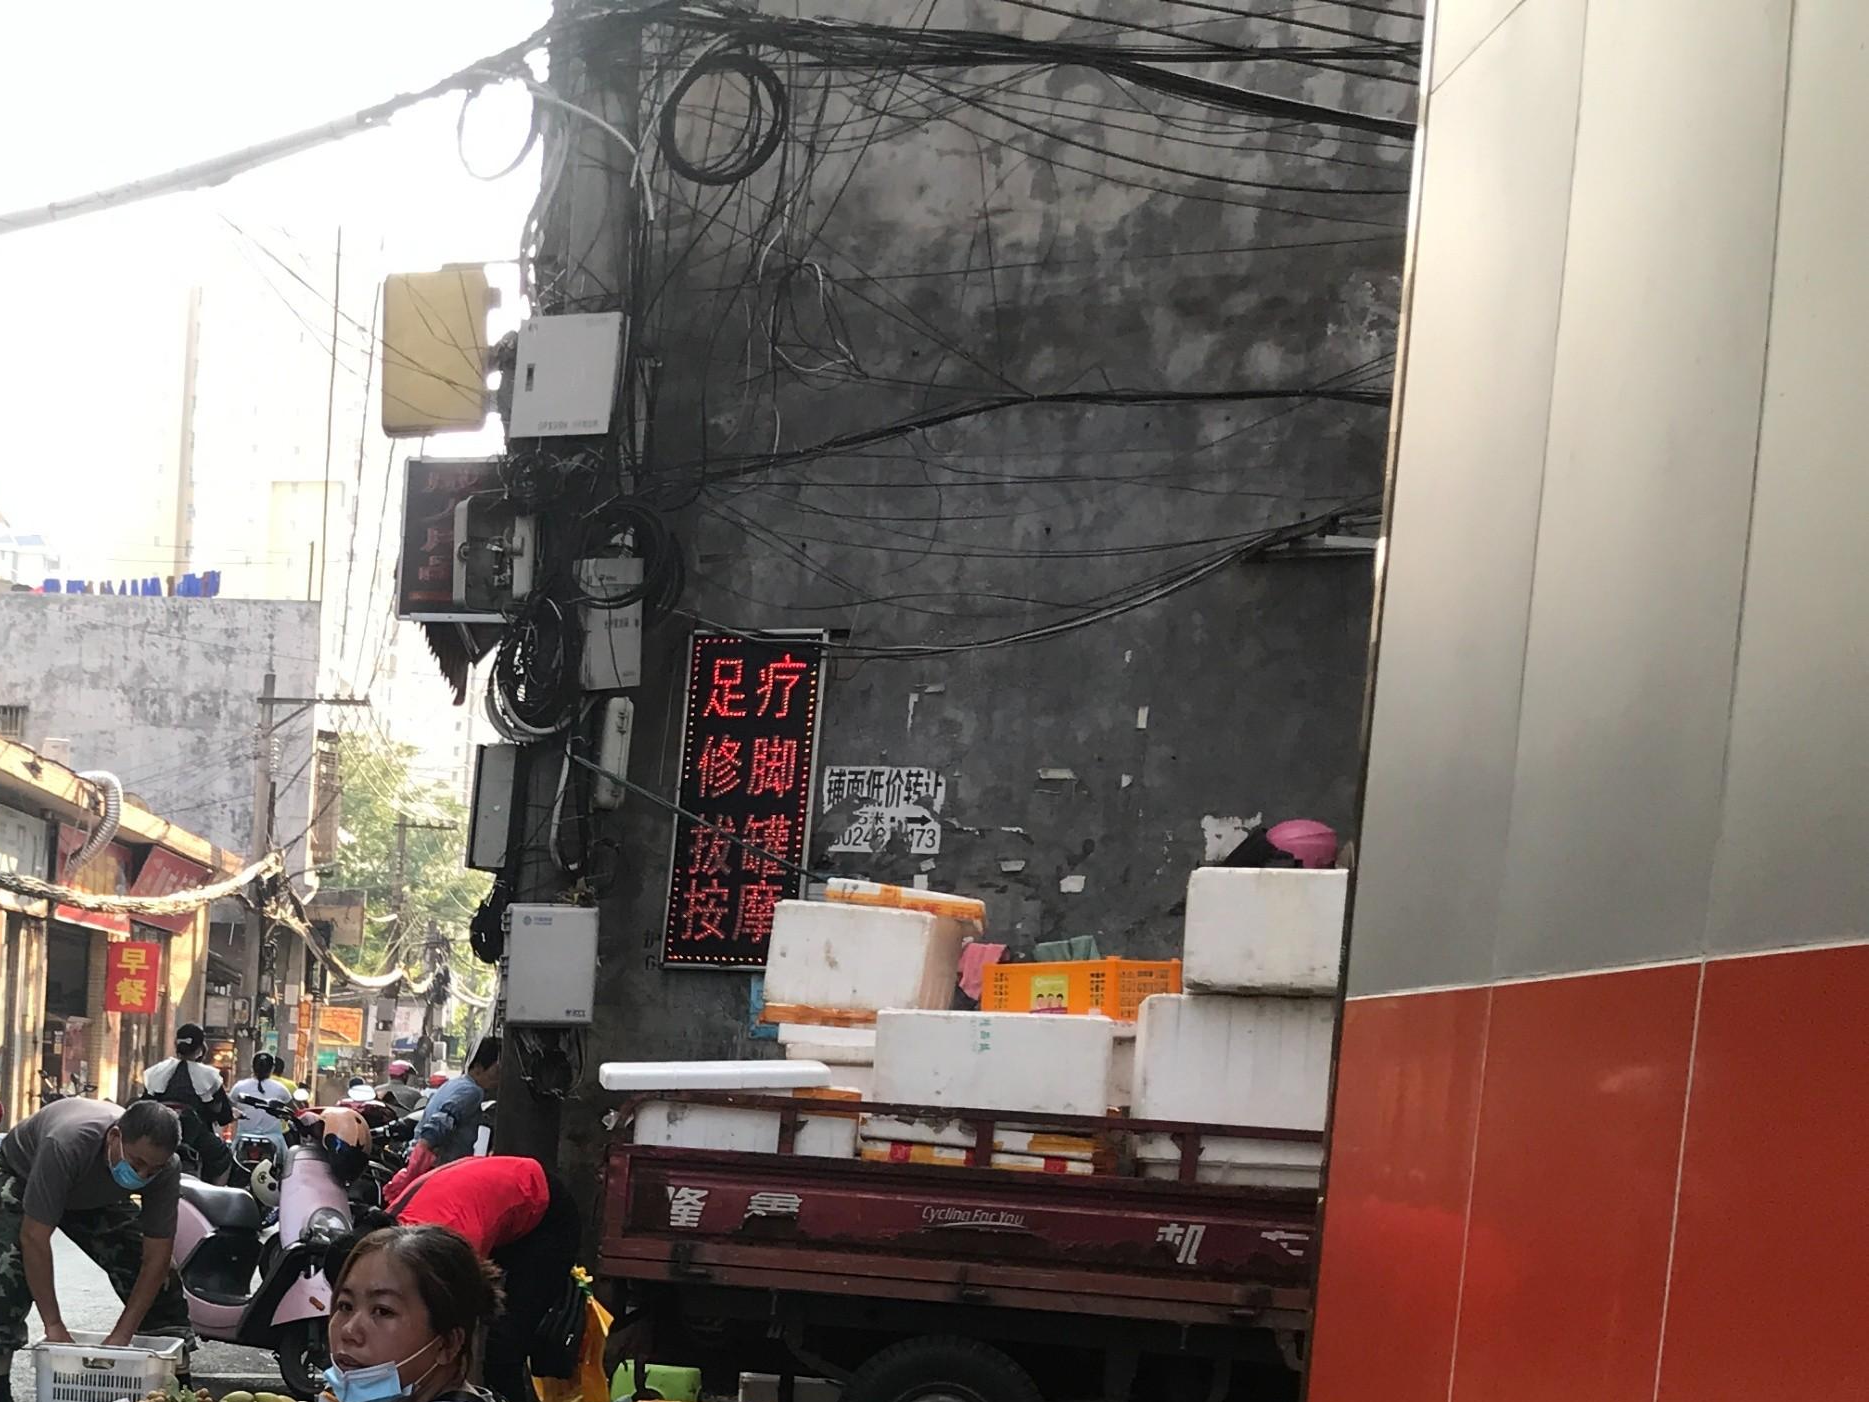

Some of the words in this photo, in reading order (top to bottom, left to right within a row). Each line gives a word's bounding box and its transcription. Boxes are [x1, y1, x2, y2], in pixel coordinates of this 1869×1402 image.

[702, 653, 807, 718] 足疗
[696, 733, 798, 798] 修脚
[688, 813, 793, 877] 拔罐
[680, 879, 782, 943] 按摩
[115, 948, 150, 1006] 早餐
[921, 1205, 970, 1223] Cycling
